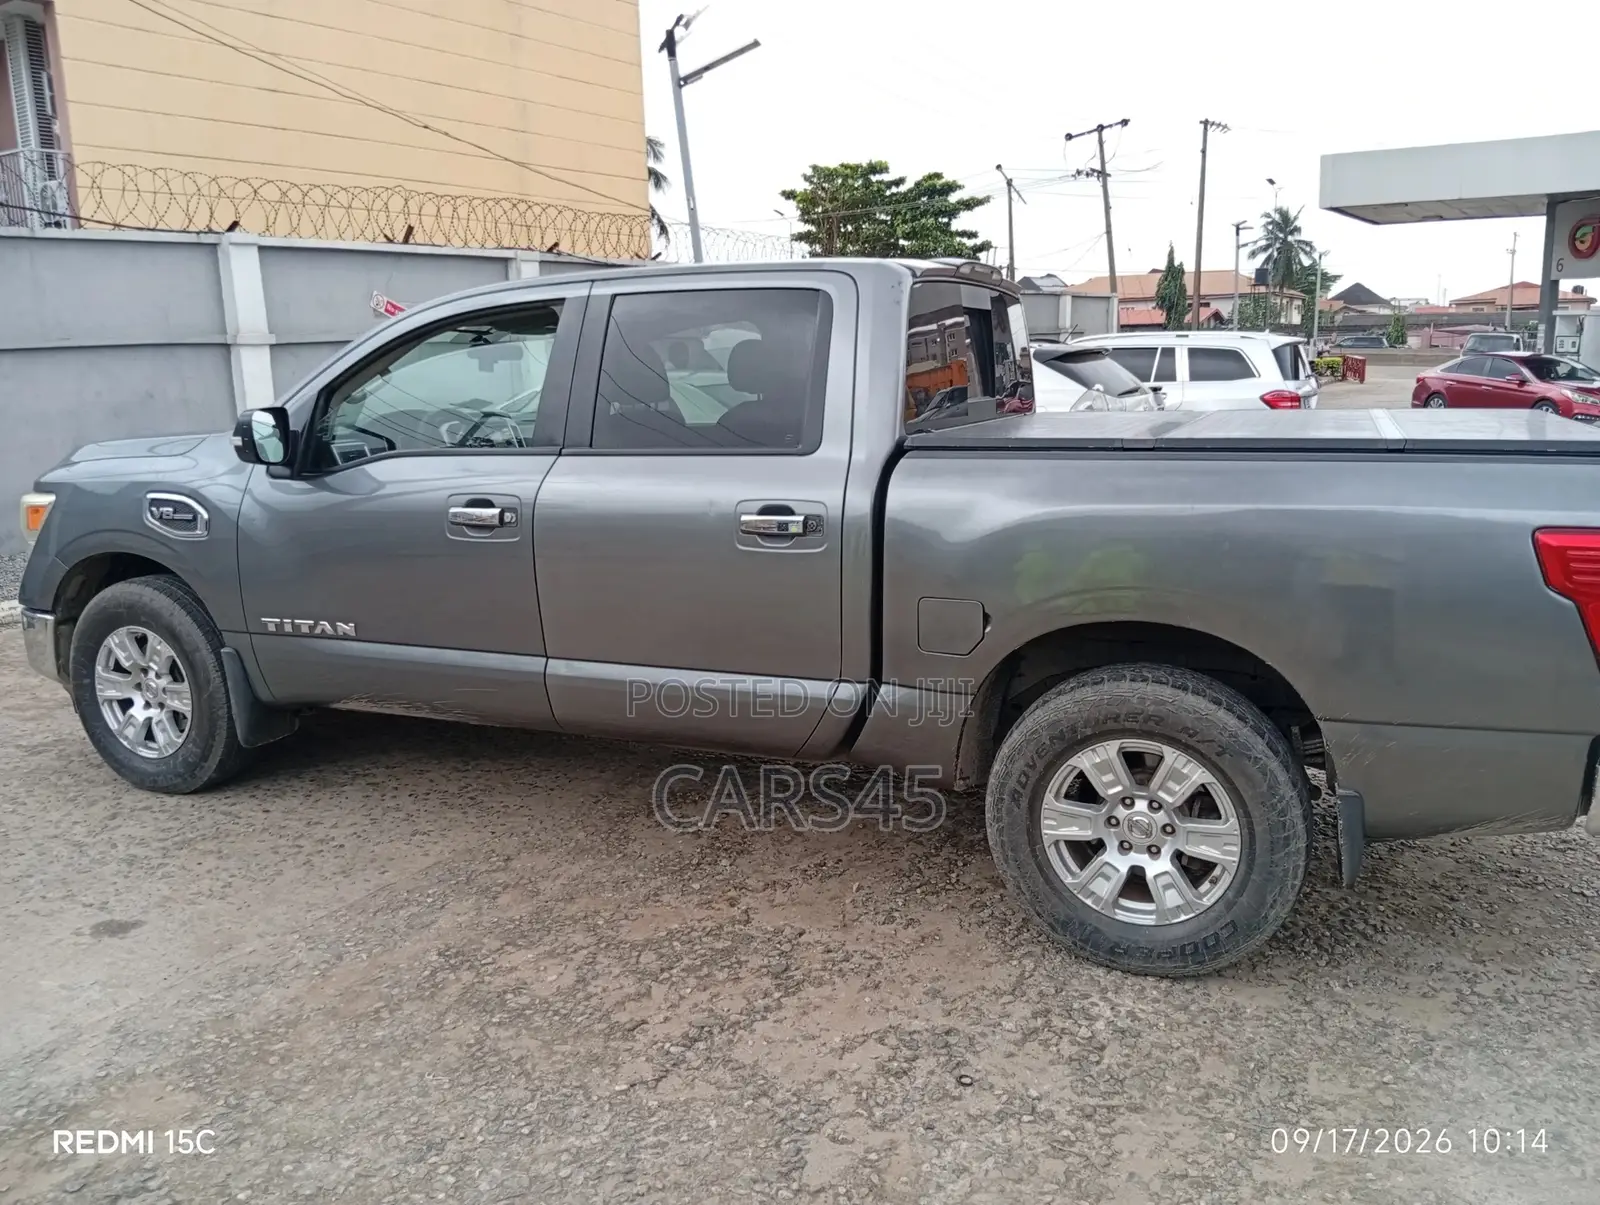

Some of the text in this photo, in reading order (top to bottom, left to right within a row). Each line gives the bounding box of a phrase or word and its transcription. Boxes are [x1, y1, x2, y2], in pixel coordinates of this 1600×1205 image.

[1556, 257, 1565, 273] 6
[150, 507, 174, 520] V8
[260, 617, 357, 637] TITAN
[1009, 710, 1167, 812] ADVENRER
